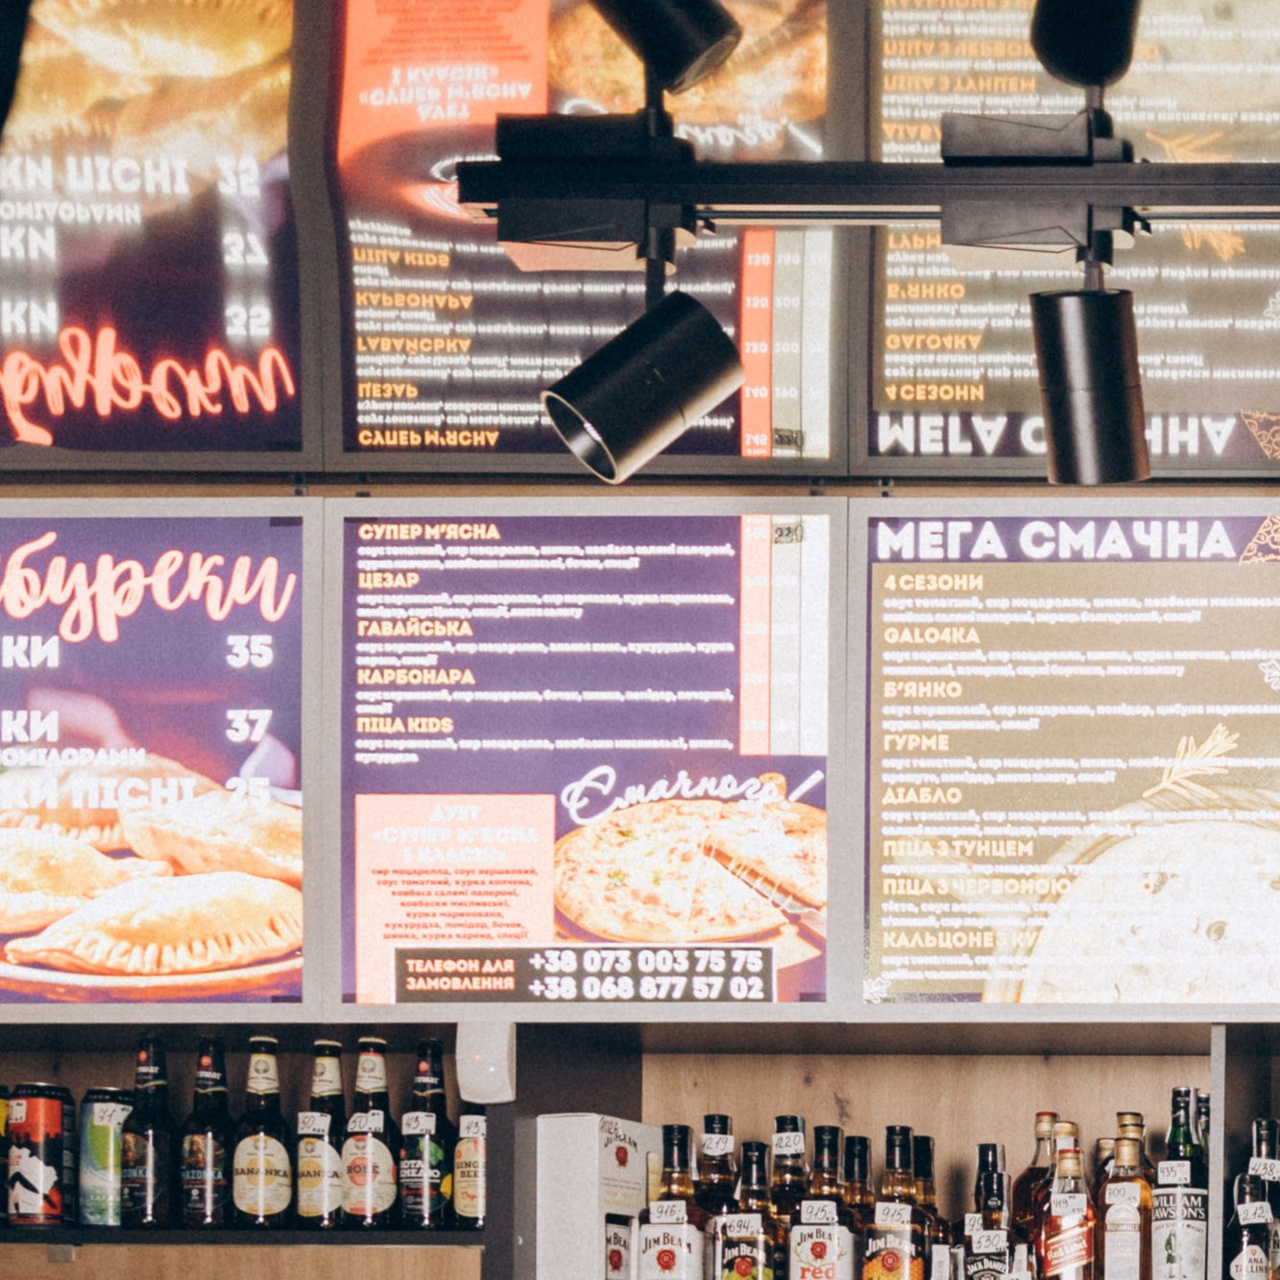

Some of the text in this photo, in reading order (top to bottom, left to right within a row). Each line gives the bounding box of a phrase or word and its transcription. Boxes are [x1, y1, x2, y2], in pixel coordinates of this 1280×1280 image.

[358, 523, 423, 541] СУПЕР
[876, 520, 1237, 560] МЕГА СМАЧНА
[357, 571, 420, 590] ЦЕЗАР
[883, 574, 984, 592] 4 СЕЗОНИ
[356, 617, 474, 637] ГАВАЙСЬКА
[883, 627, 981, 645] GALO4KA
[226, 635, 274, 668] 35
[356, 668, 476, 686] КАРБОНАРА
[226, 710, 273, 743] 37
[356, 716, 454, 736] ПІЦА KIDS
[883, 734, 950, 752] ГУРМЕ
[882, 787, 963, 805] ДІАБЛО
[951, 840, 1034, 859] ТУНЦЕМ
[405, 958, 515, 974] ТЕЛЕФОН ДЛЯ
[528, 949, 763, 974] +38 073 003 75 75
[405, 976, 515, 991] ЗАМОВЛЕННЯ
[729, 976, 764, 1000] 02
